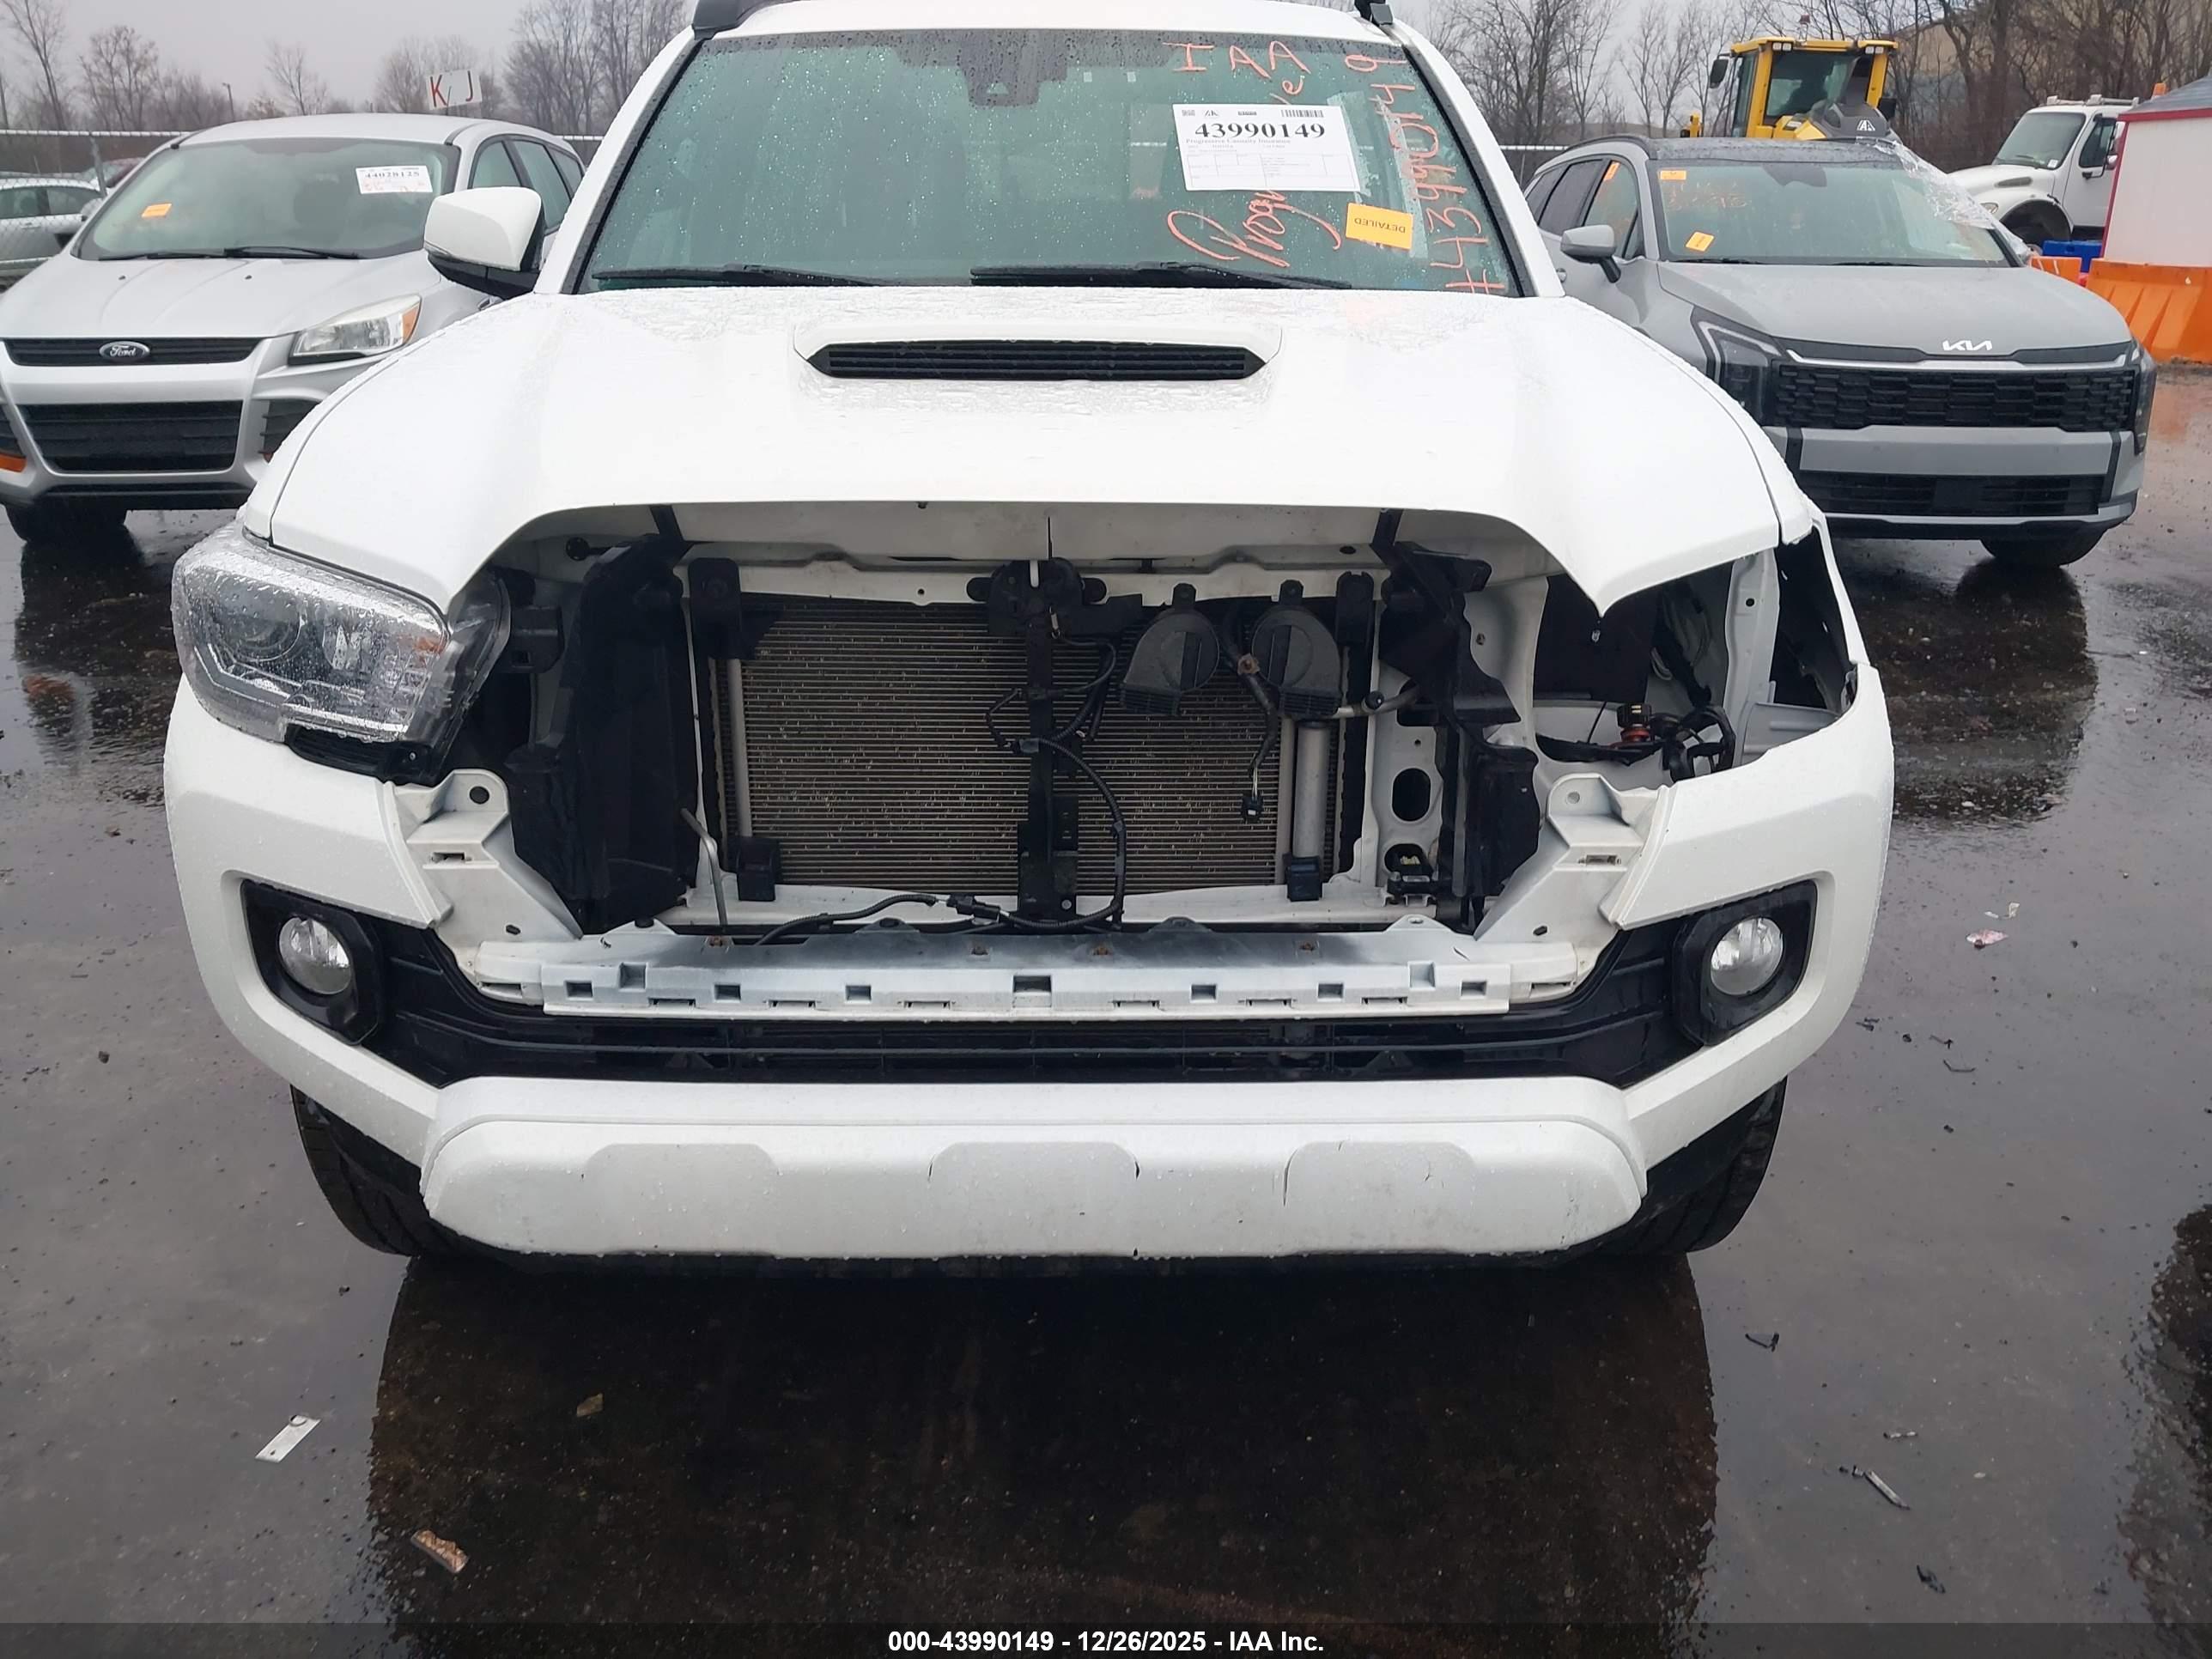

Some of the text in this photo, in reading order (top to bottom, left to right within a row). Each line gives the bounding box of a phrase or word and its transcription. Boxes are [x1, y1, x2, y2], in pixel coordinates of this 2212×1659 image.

[1194, 123, 1325, 138] 43990149
[1354, 217, 1406, 234] DETAILED
[109, 344, 137, 357] Ford
